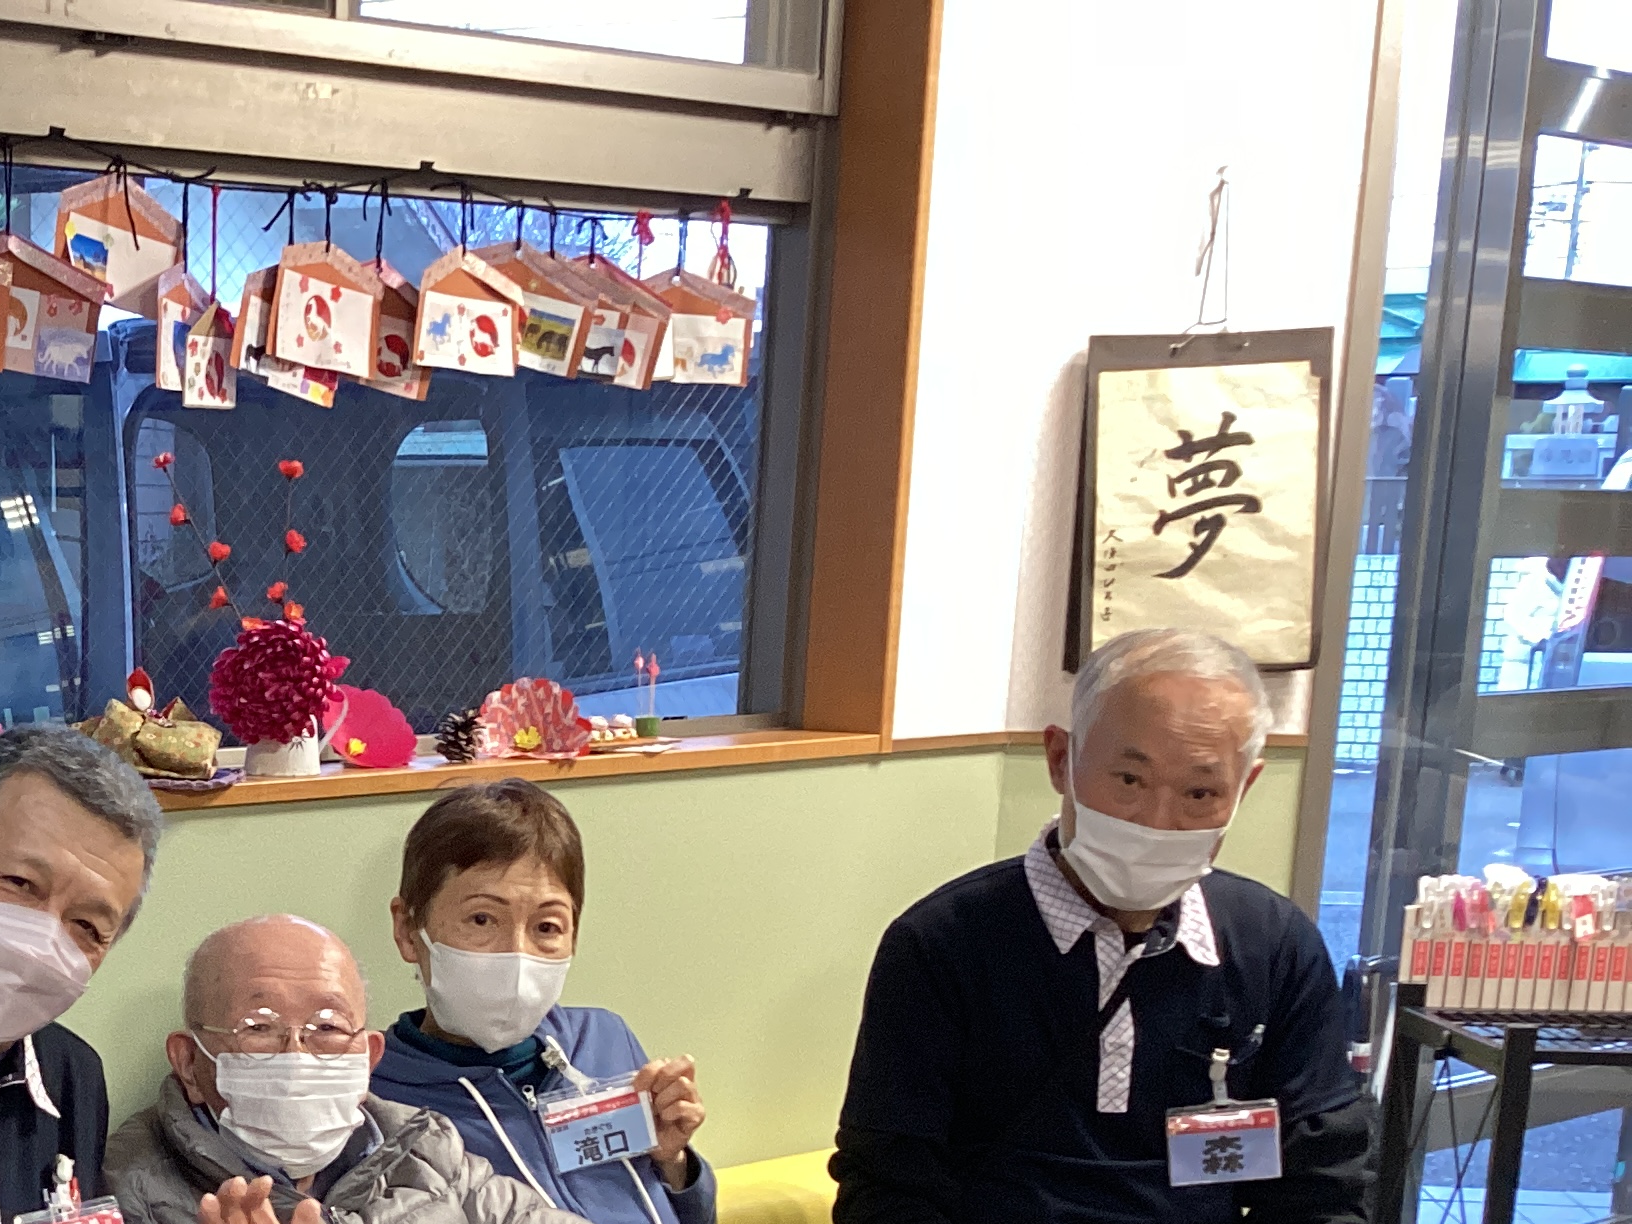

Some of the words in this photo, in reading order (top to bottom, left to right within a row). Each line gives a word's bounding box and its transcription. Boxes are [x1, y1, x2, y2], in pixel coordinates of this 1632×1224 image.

[1152, 410, 1263, 580] 夢
[573, 1130, 630, 1166] 滝口
[1201, 1134, 1245, 1175] 森
